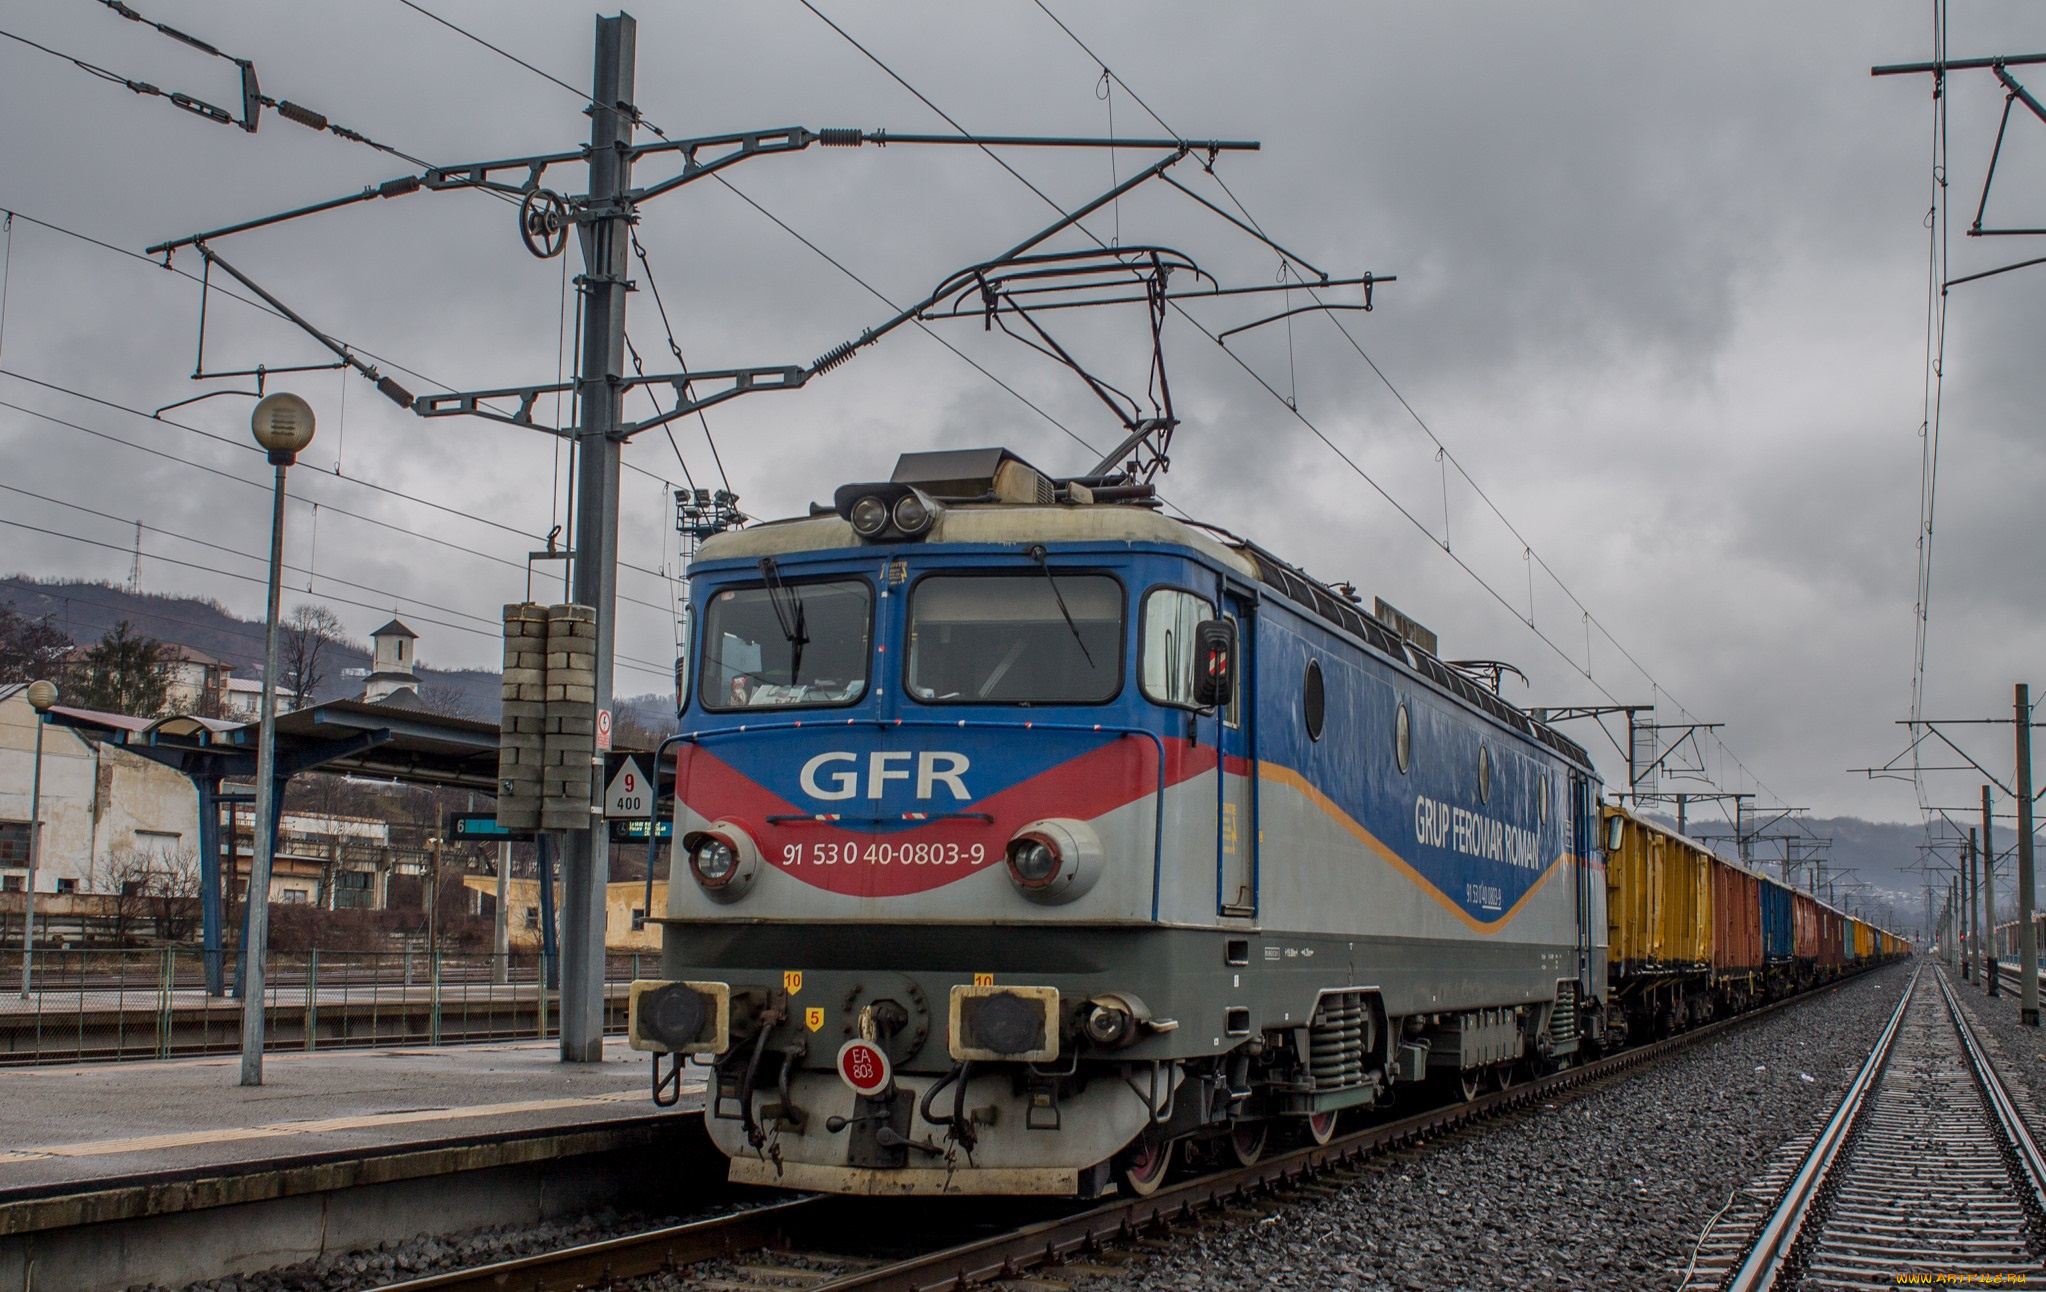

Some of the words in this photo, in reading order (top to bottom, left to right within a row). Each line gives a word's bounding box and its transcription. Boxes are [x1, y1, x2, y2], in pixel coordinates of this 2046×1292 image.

[624, 773, 635, 793] 9
[800, 751, 972, 800] GFR
[617, 797, 641, 810] 400
[457, 819, 465, 833] 6
[1415, 795, 1450, 848] GRUP
[1453, 806, 1504, 862] FEROVIAR
[1505, 823, 1540, 870] ROMAN
[783, 843, 803, 865] 91
[813, 843, 838, 864] 53
[843, 841, 858, 864] 0
[863, 843, 985, 865] 40-0803-9
[785, 974, 800, 987] 10
[976, 976, 992, 986] 10
[810, 1011, 819, 1025] 5
[852, 1049, 871, 1064] EA
[853, 1064, 873, 1079] 803
